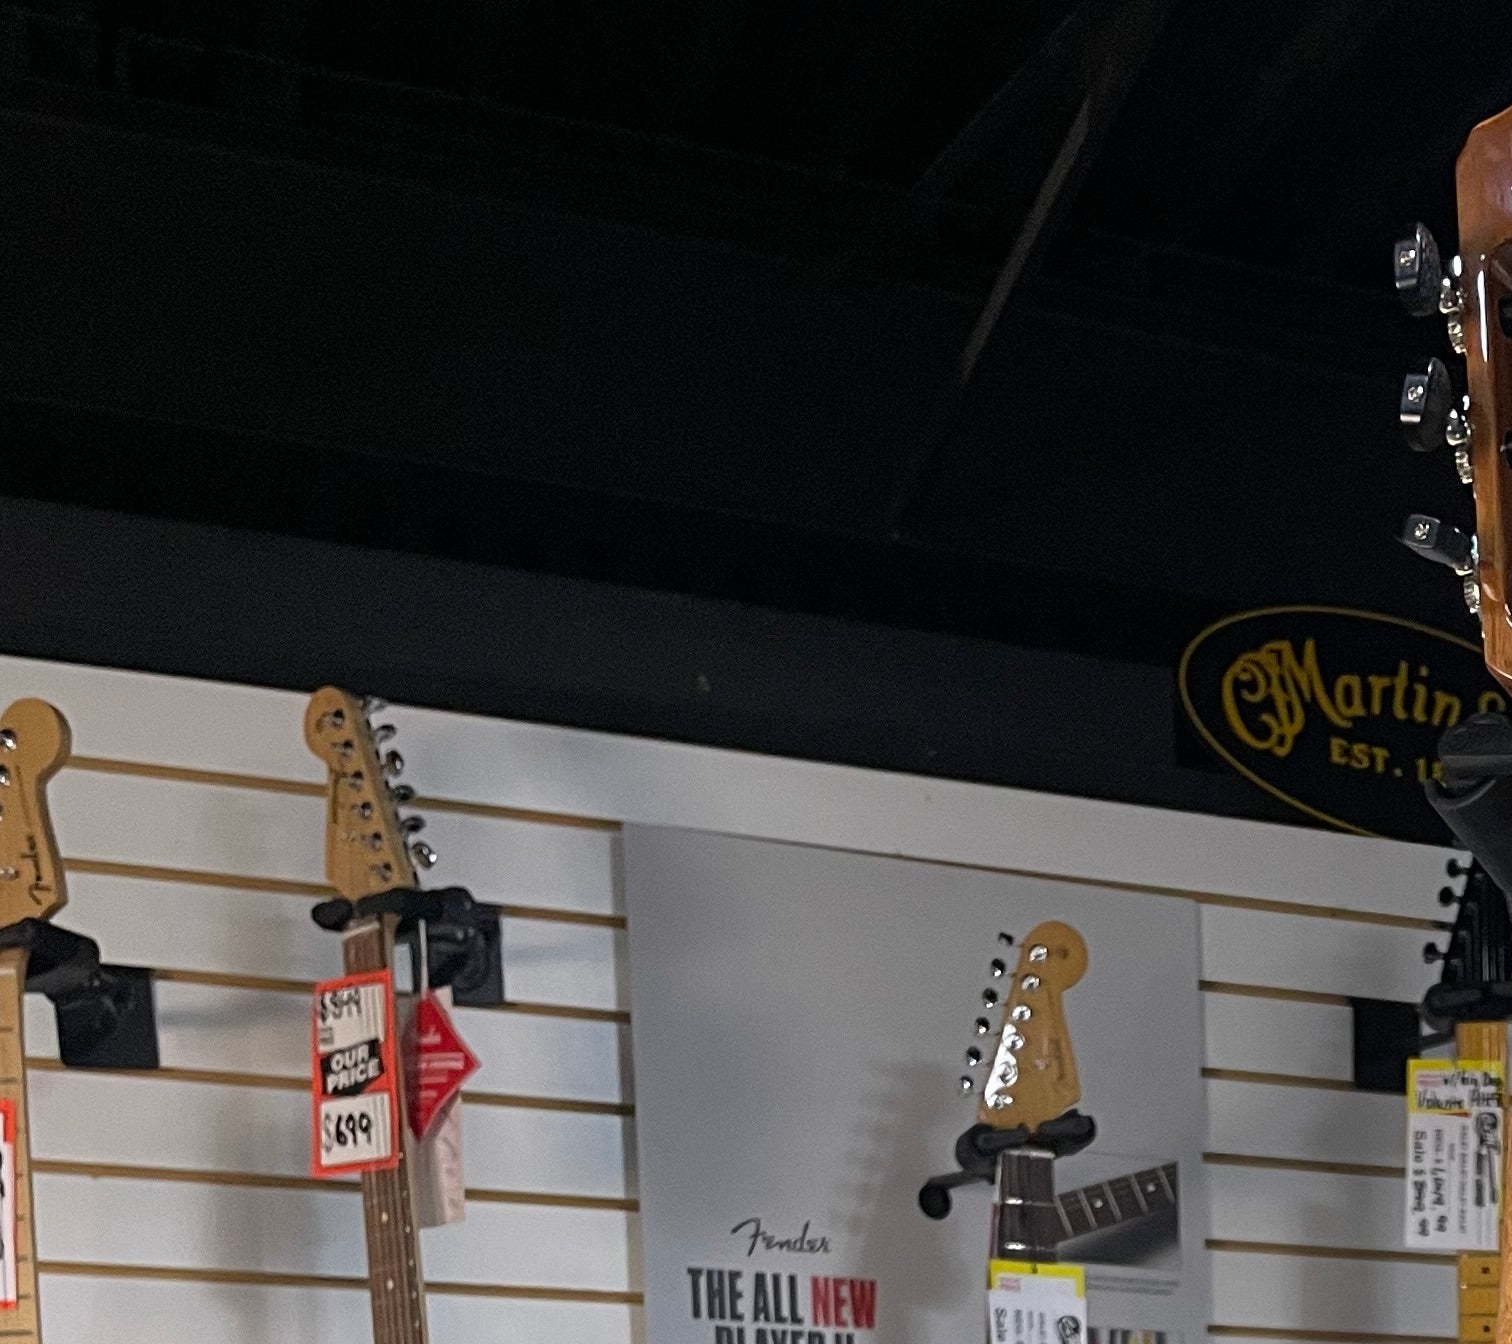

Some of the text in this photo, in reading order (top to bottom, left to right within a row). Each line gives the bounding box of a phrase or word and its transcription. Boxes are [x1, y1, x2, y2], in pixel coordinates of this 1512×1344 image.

[327, 1058, 381, 1094] PRICE
[330, 1045, 370, 1072] OUR
[323, 1112, 372, 1152] $699
[730, 1217, 831, 1257] Fender
[687, 1267, 877, 1329] THE ALL NEW
